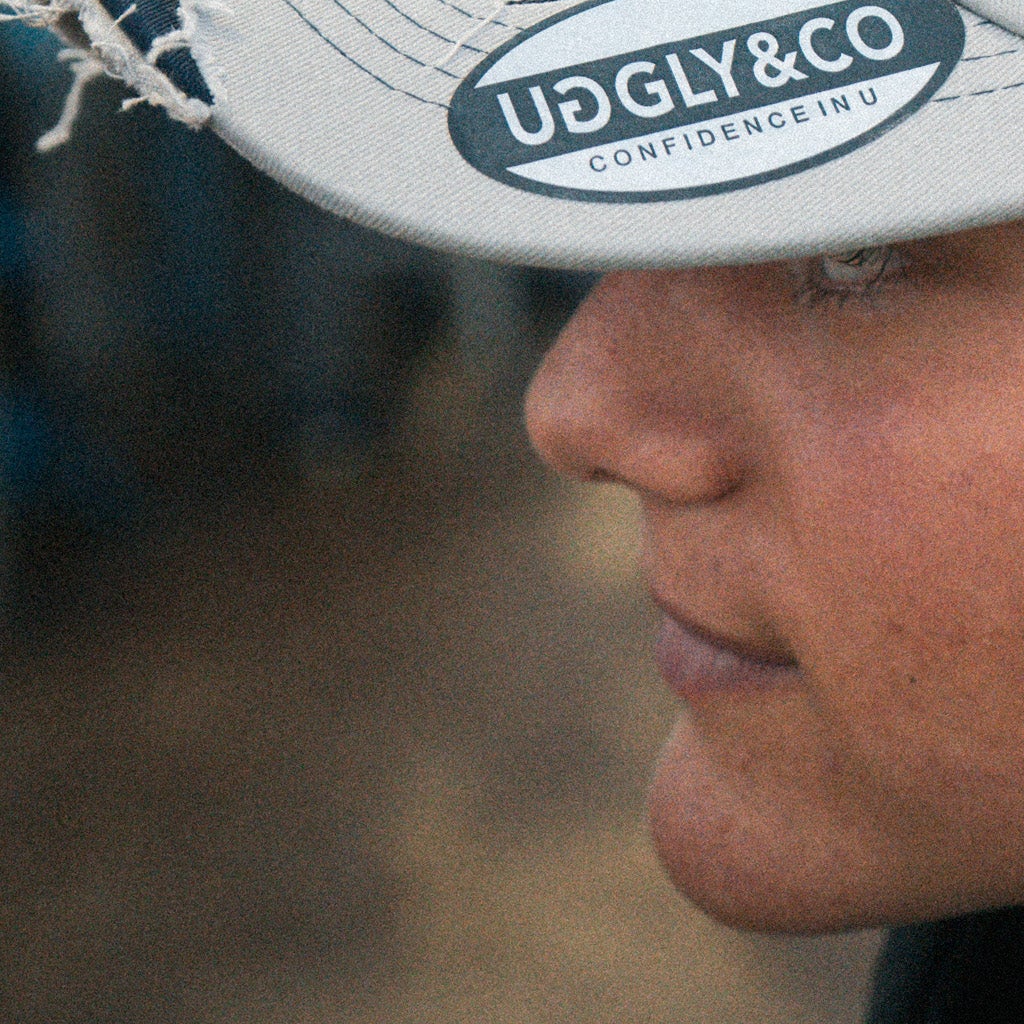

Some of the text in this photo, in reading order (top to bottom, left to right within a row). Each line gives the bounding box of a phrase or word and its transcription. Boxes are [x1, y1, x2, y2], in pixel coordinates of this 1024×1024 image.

[497, 5, 905, 146] UGGLY&CO
[588, 86, 879, 172] CONFIDENCE IN U
